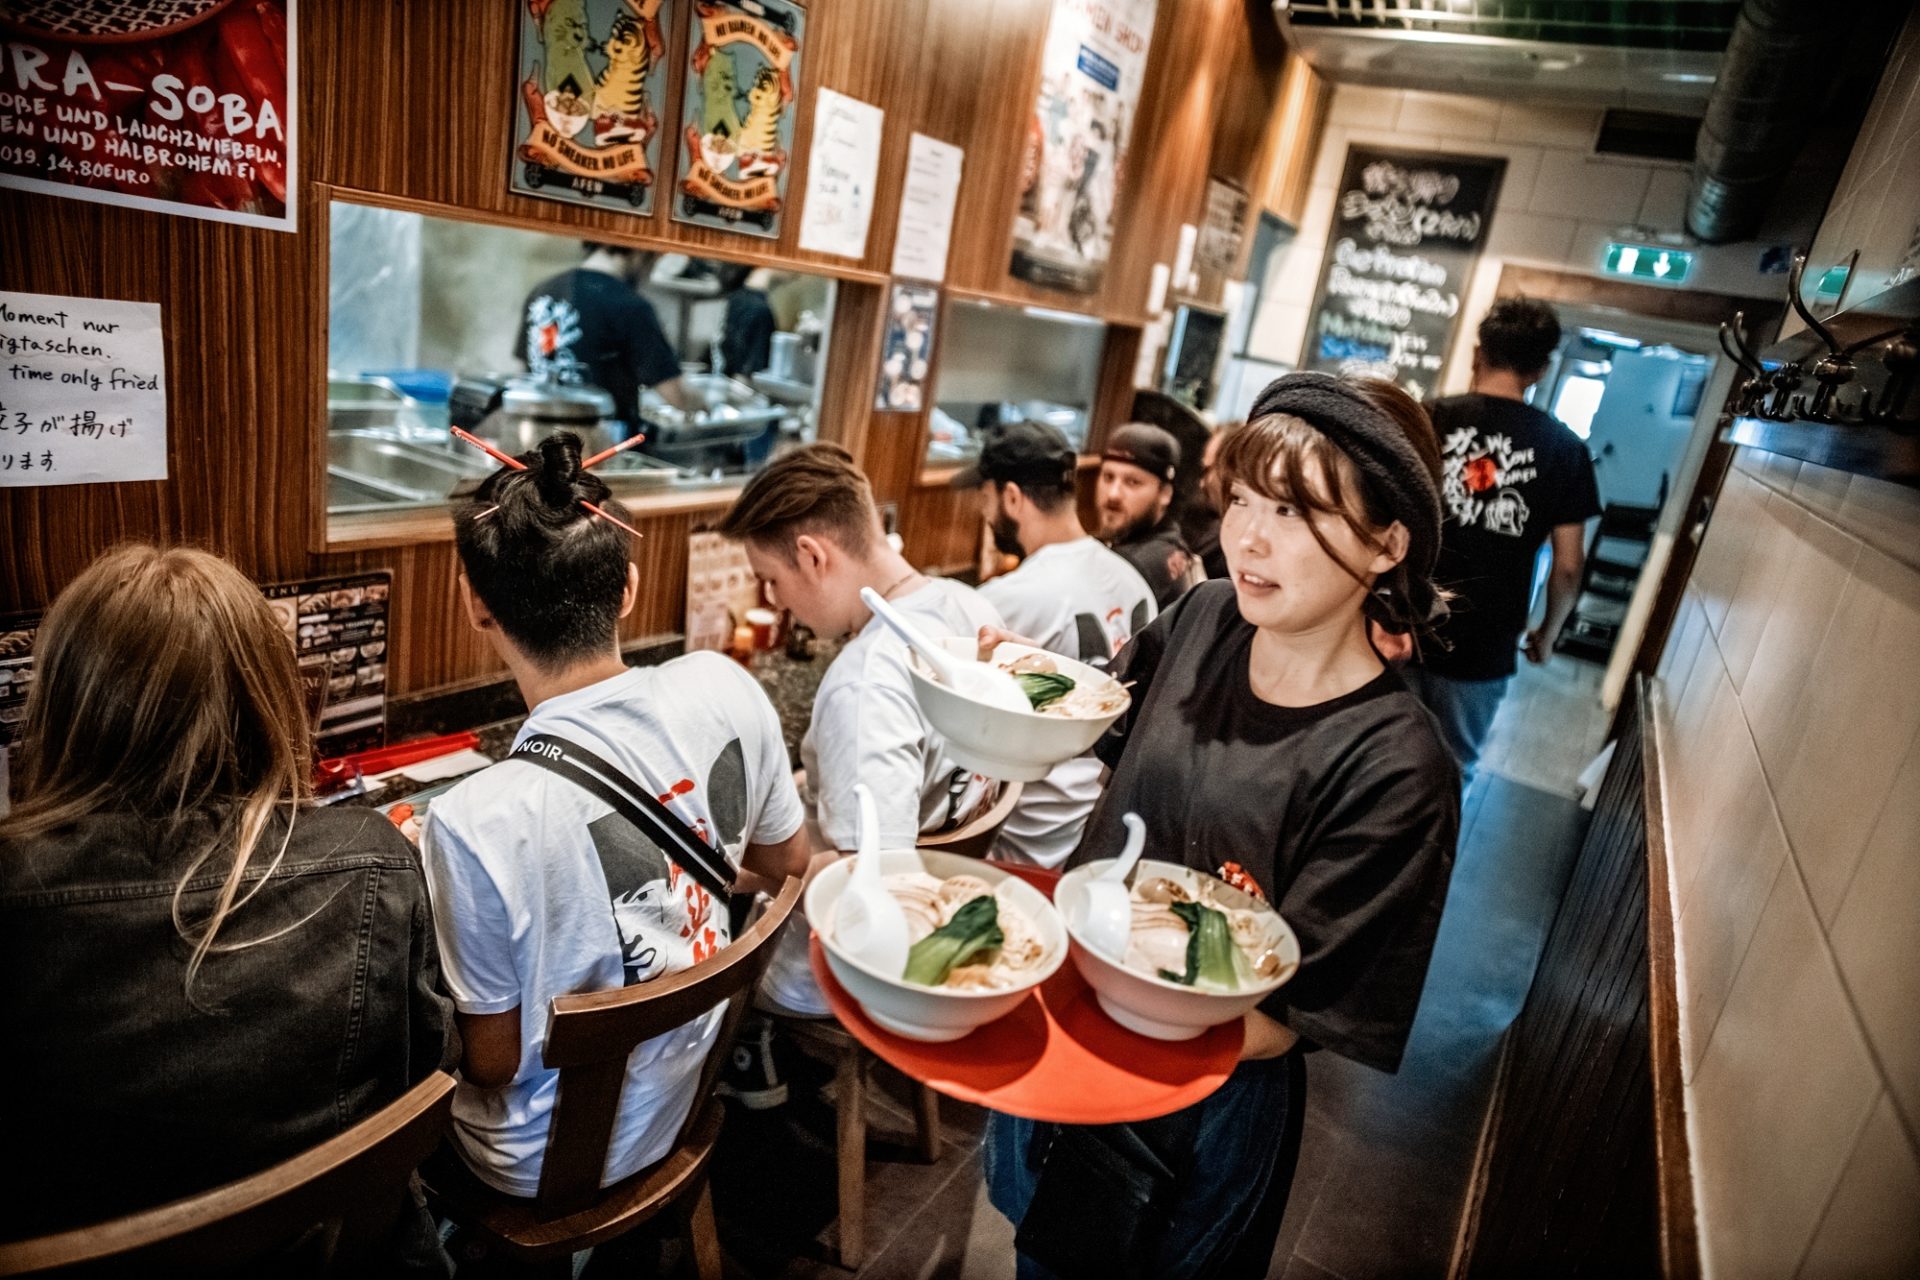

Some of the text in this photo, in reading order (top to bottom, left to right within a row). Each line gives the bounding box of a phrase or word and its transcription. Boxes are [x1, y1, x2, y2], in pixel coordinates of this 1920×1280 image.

[56, 104, 109, 131] UND
[43, 125, 97, 151] UND
[542, 129, 559, 148] NO
[602, 155, 616, 170] NO
[83, 321, 120, 334] nur
[9, 364, 159, 392] time only fried
[1485, 432, 1512, 455] WE
[1499, 447, 1535, 473] LOVE
[517, 739, 563, 762] NOIR
